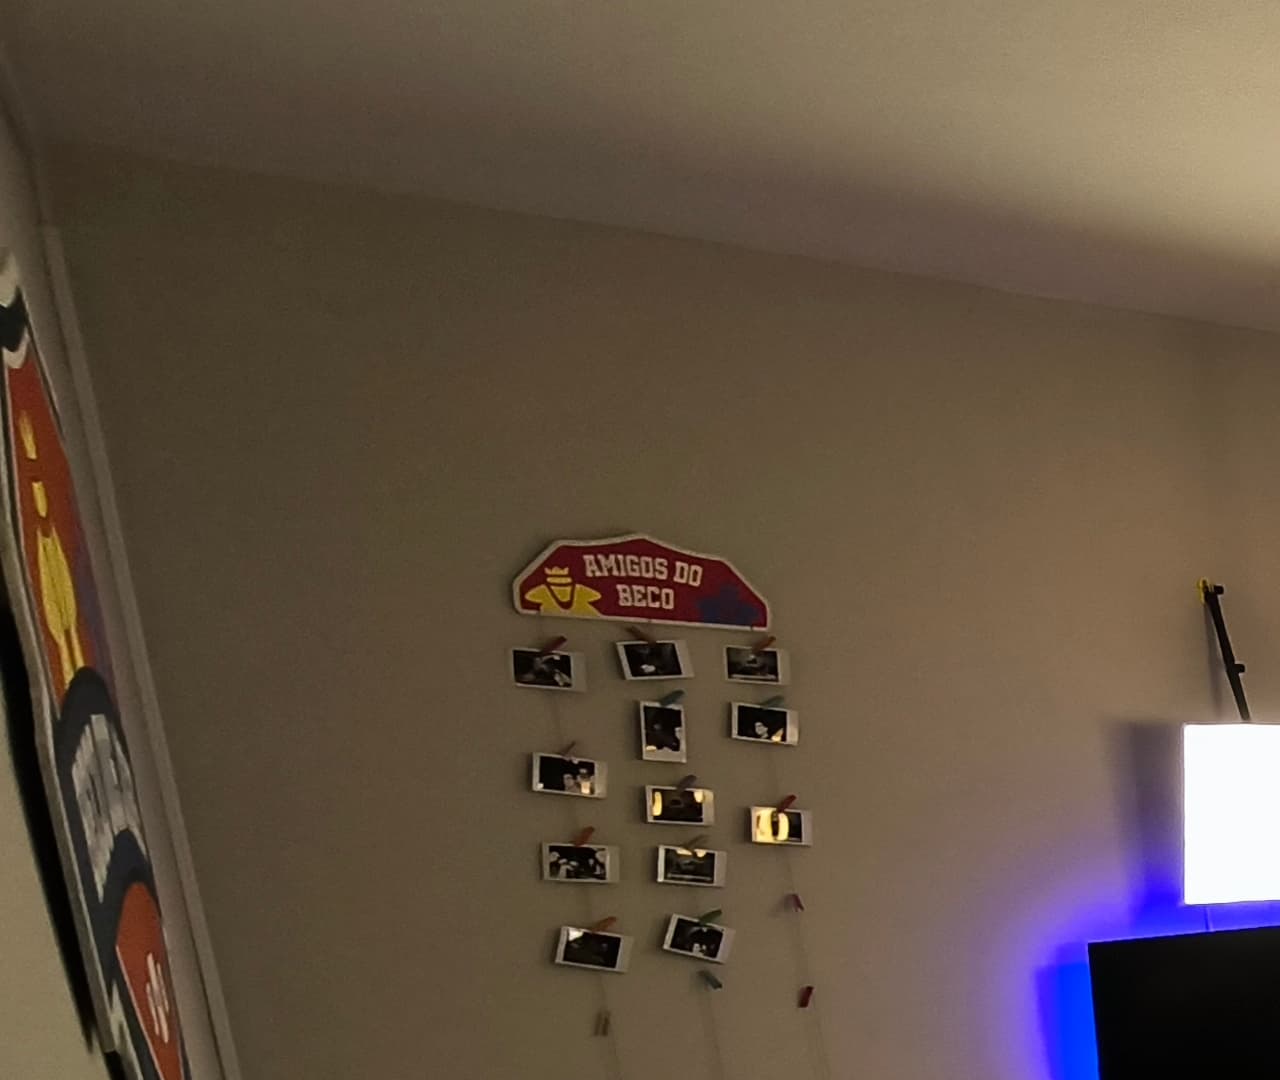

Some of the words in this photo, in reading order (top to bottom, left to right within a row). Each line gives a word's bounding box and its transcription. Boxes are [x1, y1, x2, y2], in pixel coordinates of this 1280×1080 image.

[583, 555, 668, 580] AMIGOS
[674, 562, 703, 587] DO
[618, 584, 674, 610] BECO
